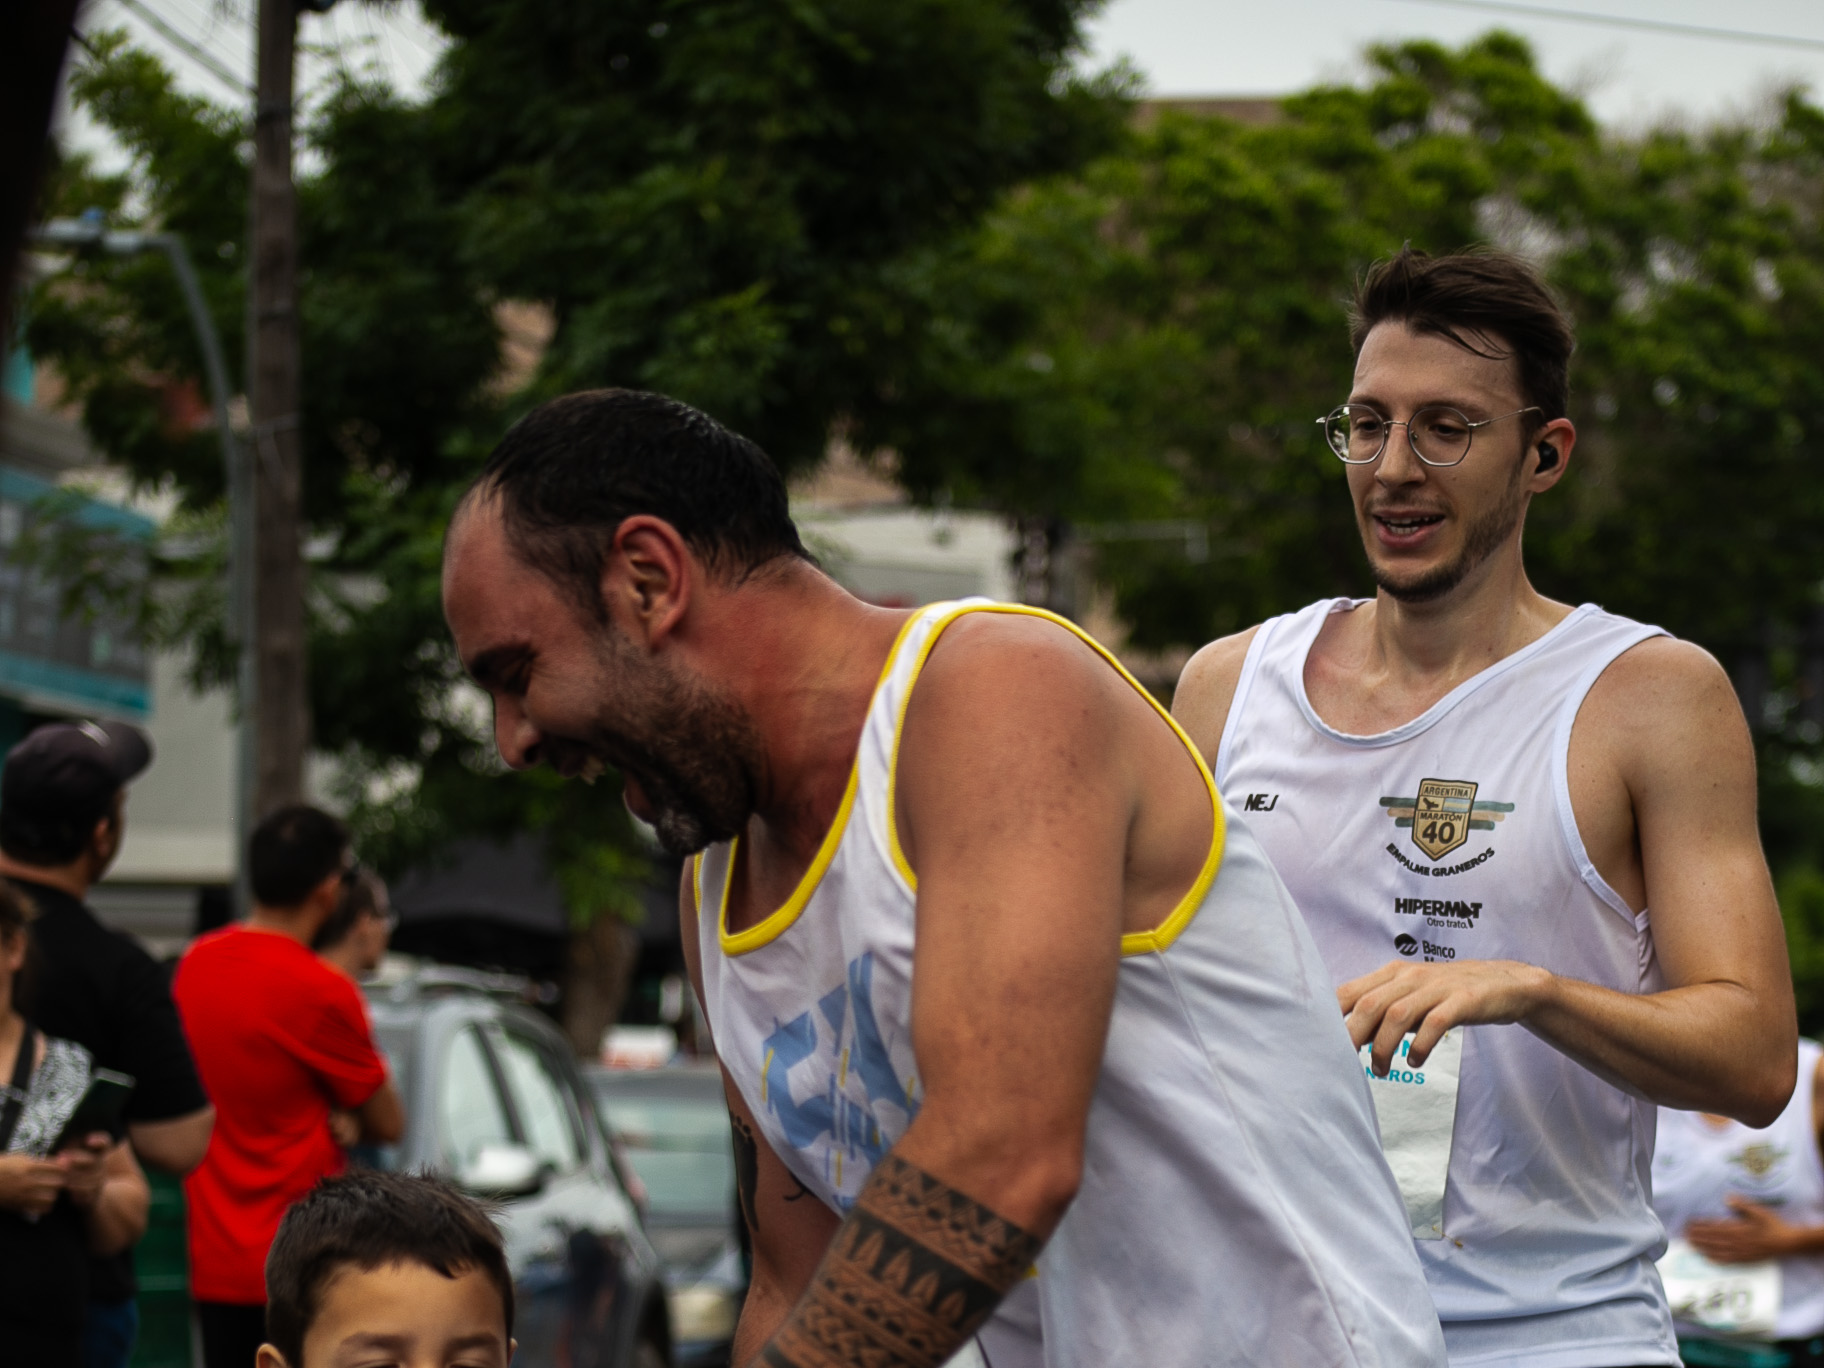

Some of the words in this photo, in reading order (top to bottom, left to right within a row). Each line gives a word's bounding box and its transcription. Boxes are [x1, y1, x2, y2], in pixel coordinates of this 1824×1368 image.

[1423, 786, 1469, 797] ARGENTINA
[1244, 794, 1279, 811] NEJ
[1420, 812, 1462, 822] MARATÓN
[1422, 821, 1455, 844] 40
[1386, 843, 1430, 876] EMPALME
[1432, 847, 1495, 877] GRANEROS
[1426, 917, 1445, 928] Otro
[1422, 939, 1456, 959] Banco
